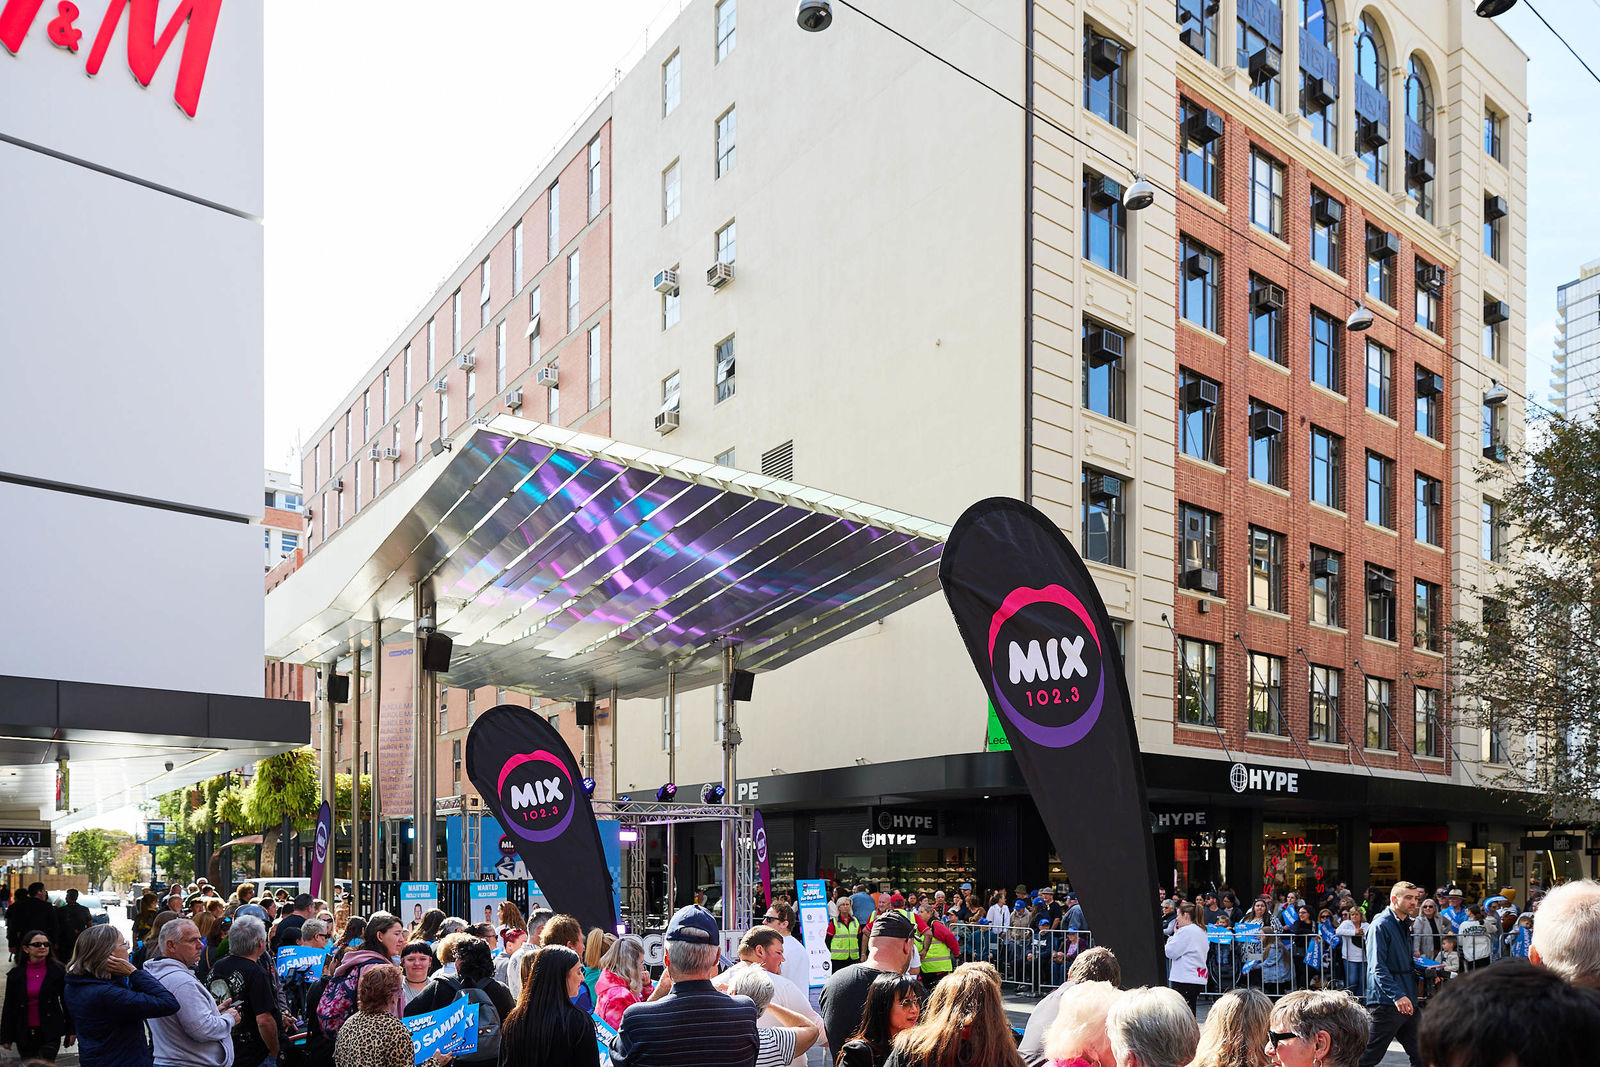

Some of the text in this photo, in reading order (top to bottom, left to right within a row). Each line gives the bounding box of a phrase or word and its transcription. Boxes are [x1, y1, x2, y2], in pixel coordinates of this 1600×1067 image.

[0, 0, 222, 119] &M
[1009, 635, 1088, 684] MIX
[1026, 686, 1080, 707] 102.3
[1249, 769, 1298, 792] HYPE
[510, 777, 564, 810] MIX
[737, 782, 758, 800] PE
[522, 806, 558, 820] 102.3
[893, 816, 933, 828] HYPE
[1158, 812, 1206, 826] HYPE
[0, 836, 34, 846] LAZA
[876, 833, 917, 846] HYPE
[1263, 837, 1325, 894] STRANDBAGS
[286, 955, 322, 970] SAMMY
[413, 1040, 422, 1054] O
[423, 1005, 464, 1046] SAMMY
